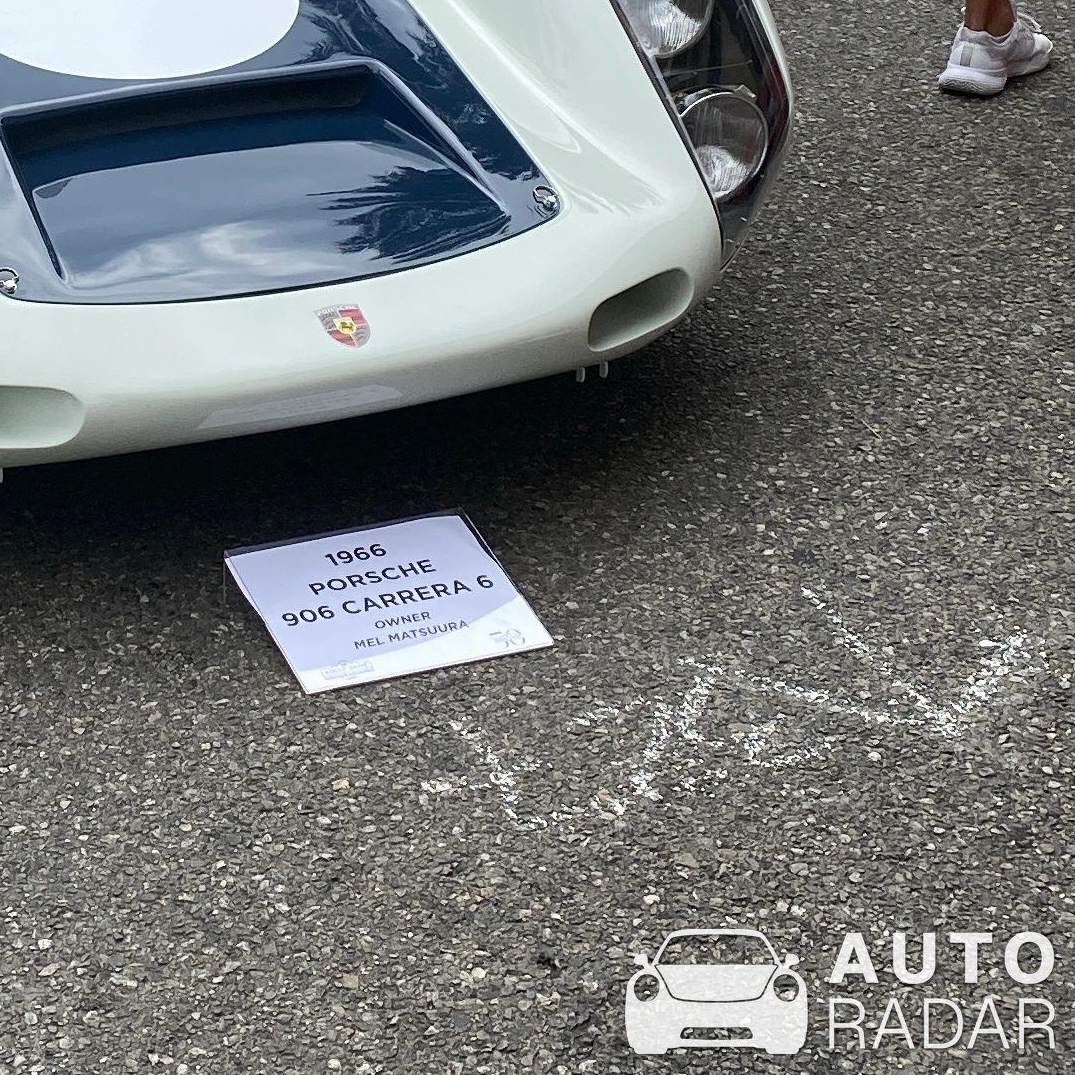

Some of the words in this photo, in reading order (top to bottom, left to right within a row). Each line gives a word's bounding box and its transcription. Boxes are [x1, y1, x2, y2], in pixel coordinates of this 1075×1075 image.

[324, 543, 387, 566] 1966
[308, 559, 437, 596] PORSCHE
[281, 605, 335, 627] 906
[342, 579, 472, 615] CARRERA
[476, 574, 494, 589] 6
[354, 637, 386, 650] MEL
[389, 619, 469, 644] MATSUURA
[374, 611, 432, 629] OWNER
